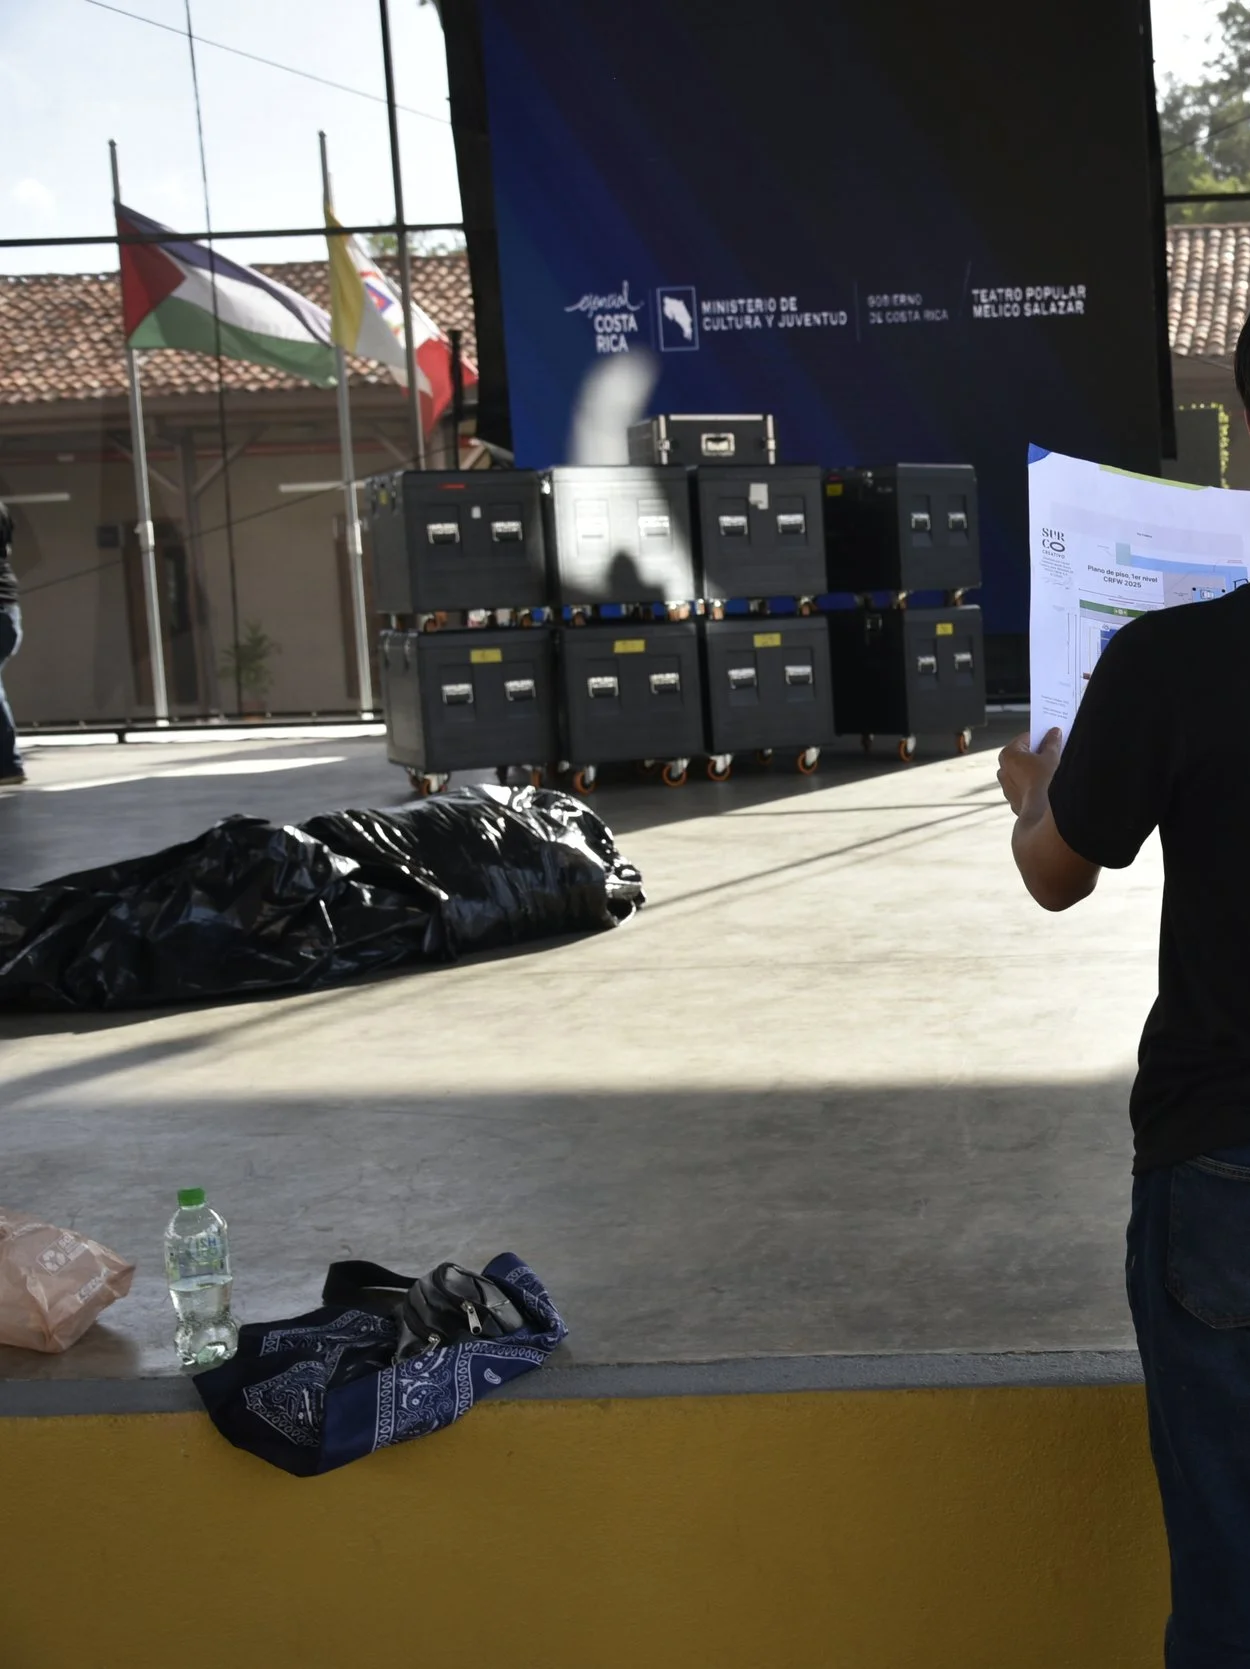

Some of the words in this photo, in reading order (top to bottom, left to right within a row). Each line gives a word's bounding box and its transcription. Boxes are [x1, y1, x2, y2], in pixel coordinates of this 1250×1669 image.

[971, 287, 1023, 304] TEATRO
[1025, 284, 1087, 301] POPULAR
[701, 298, 777, 315] MINISTERIO
[779, 296, 798, 312] DE
[973, 303, 1021, 319] MELICO
[1023, 300, 1086, 317] SALAZAR
[594, 313, 638, 334] COSTA
[702, 314, 763, 331] CULTURA
[764, 314, 774, 328] Y
[777, 311, 848, 329] JUVENTUD
[885, 309, 921, 324] COSTA
[923, 308, 949, 322] RICA
[596, 334, 630, 353] RICA
[1041, 527, 1065, 542] SUR
[1041, 539, 1066, 552] CO
[1087, 565, 1105, 574] Plano
[1103, 576, 1123, 585] CRFW
[1124, 580, 1142, 588] 2025
